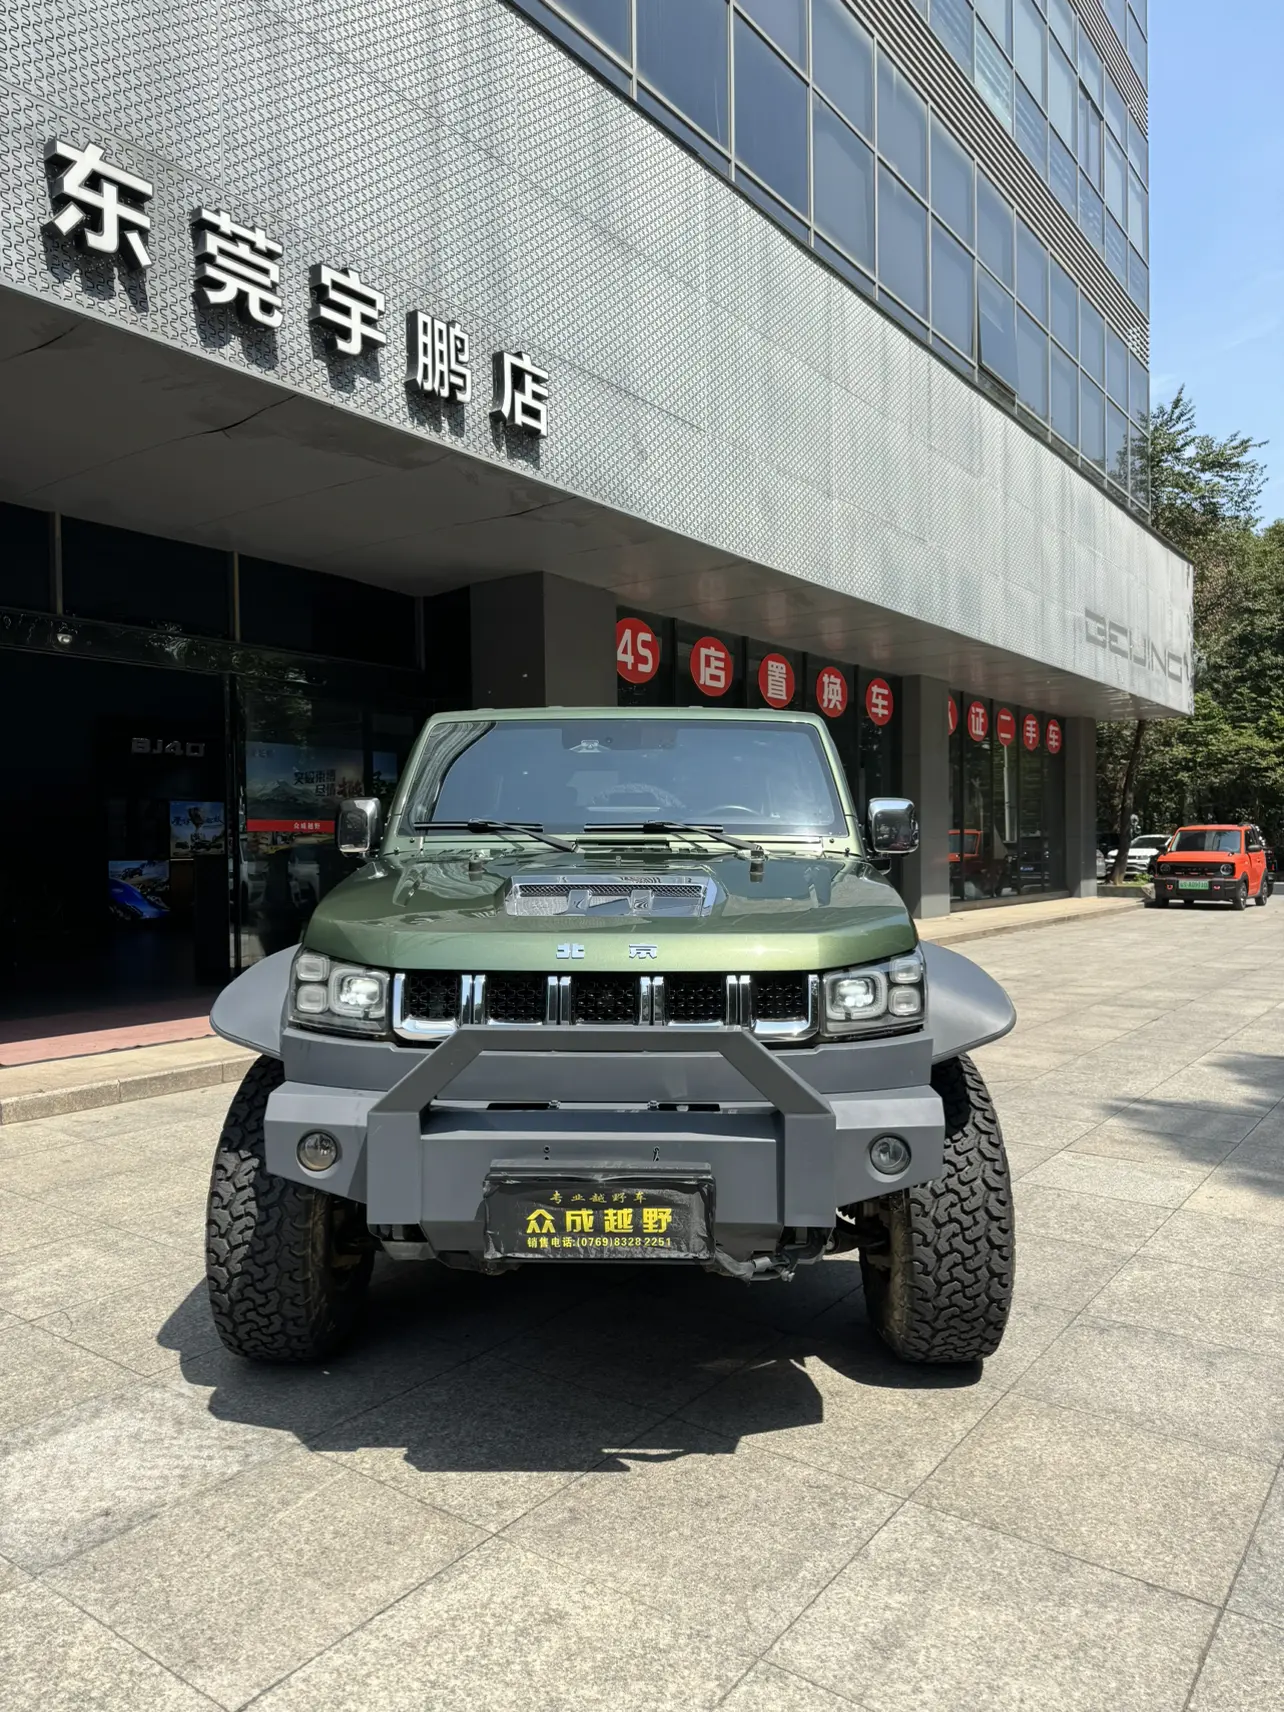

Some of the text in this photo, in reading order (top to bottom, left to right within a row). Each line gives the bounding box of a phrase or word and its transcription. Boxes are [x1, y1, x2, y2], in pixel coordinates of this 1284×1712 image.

[46, 138, 549, 438] 东莞宇鹏店
[616, 627, 890, 720] 4S店置换车
[131, 737, 206, 758] BJ40
[550, 1190, 647, 1205] 专业越野车
[526, 1208, 673, 1234] 众成越野
